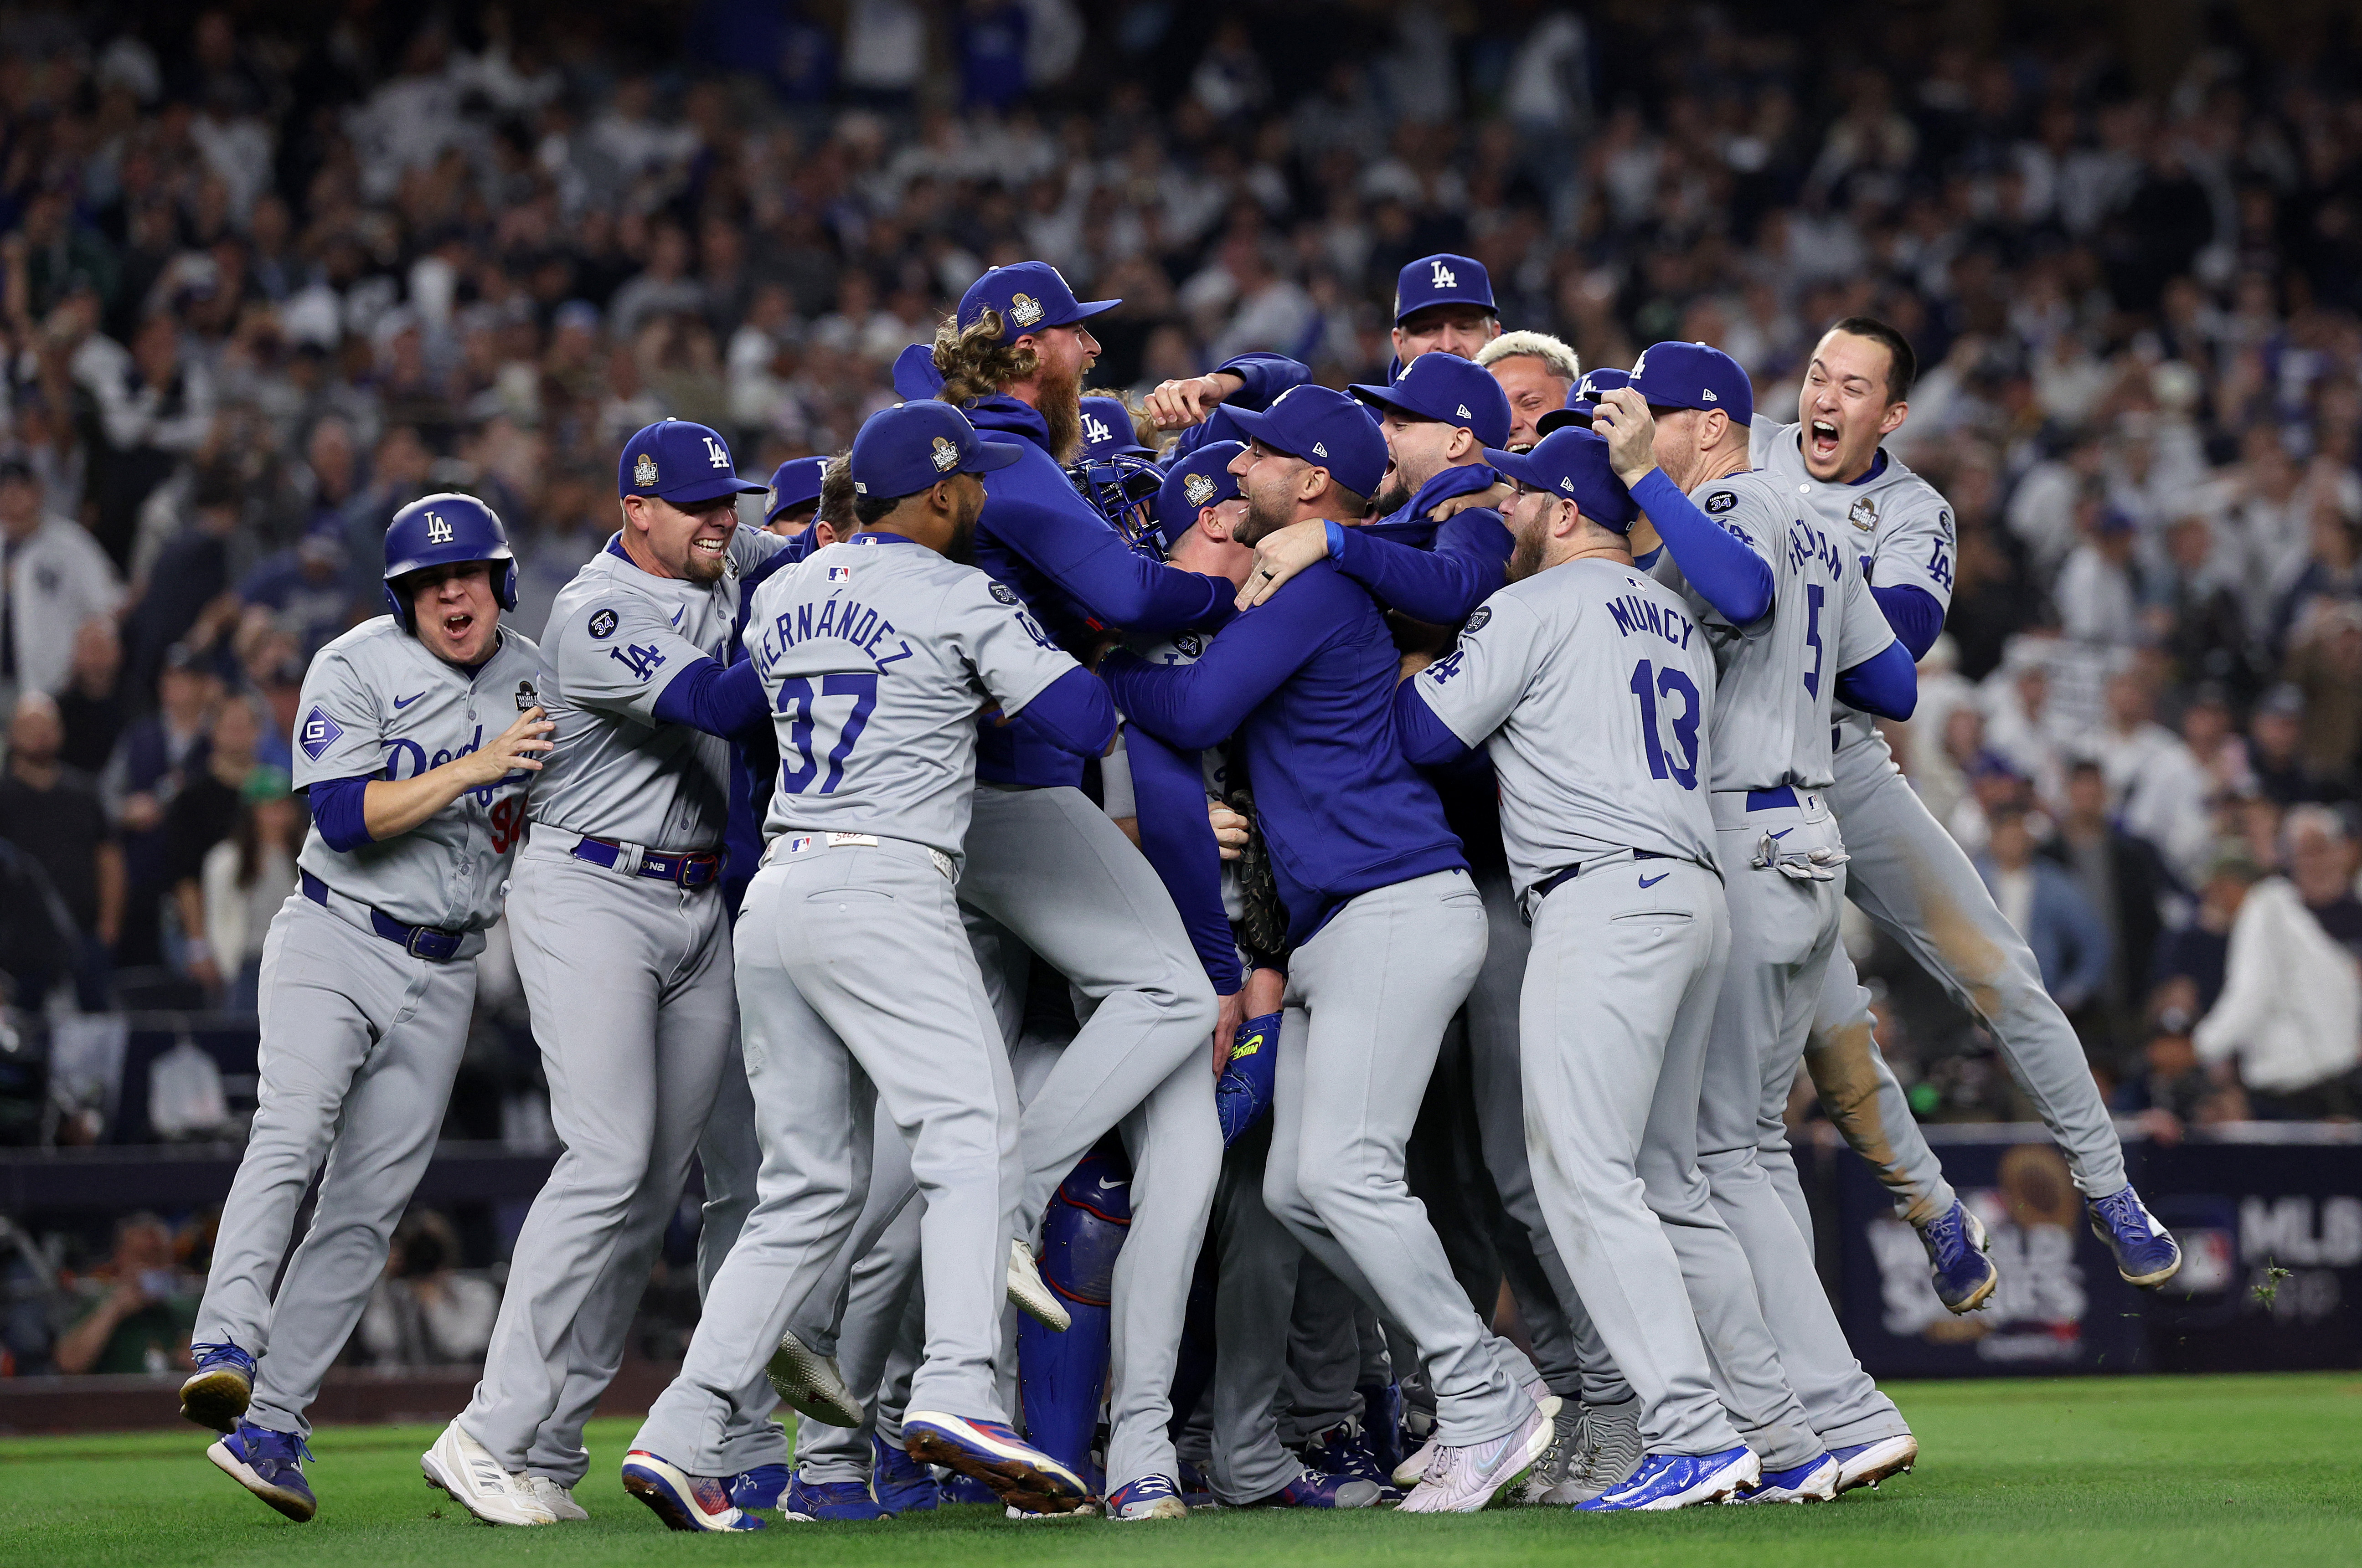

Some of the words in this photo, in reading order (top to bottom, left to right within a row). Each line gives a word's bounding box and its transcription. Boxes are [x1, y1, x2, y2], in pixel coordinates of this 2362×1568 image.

[1431, 260, 1457, 288] LA
[1012, 302, 1036, 315] WORLD
[1016, 307, 1039, 322] SERIES
[1080, 413, 1112, 443] LA
[702, 437, 729, 468] LA
[933, 446, 956, 462] WORLD
[937, 451, 958, 467] SERIES
[635, 467, 656, 475] WORLD
[636, 473, 656, 481] SERIES
[1187, 478, 1211, 496] WORLD
[1191, 485, 1213, 502] SERIES
[1710, 494, 1731, 502] FERNANDO
[1711, 498, 1731, 511] 34
[424, 511, 453, 544] LA
[1927, 537, 1952, 594] LA
[591, 612, 609, 626] FERNANDO
[595, 616, 614, 635] 34
[1467, 616, 1485, 629] 34
[1606, 595, 1693, 650] MUNCY
[758, 588, 913, 682] HERNÁNDEZ
[1804, 584, 1824, 703] 5
[1179, 638, 1196, 655] 34
[610, 643, 666, 682] LA
[307, 720, 325, 739] G
[776, 673, 878, 794] 37
[1630, 659, 1700, 791] 13
[1232, 1043, 1259, 1060] NIKE
